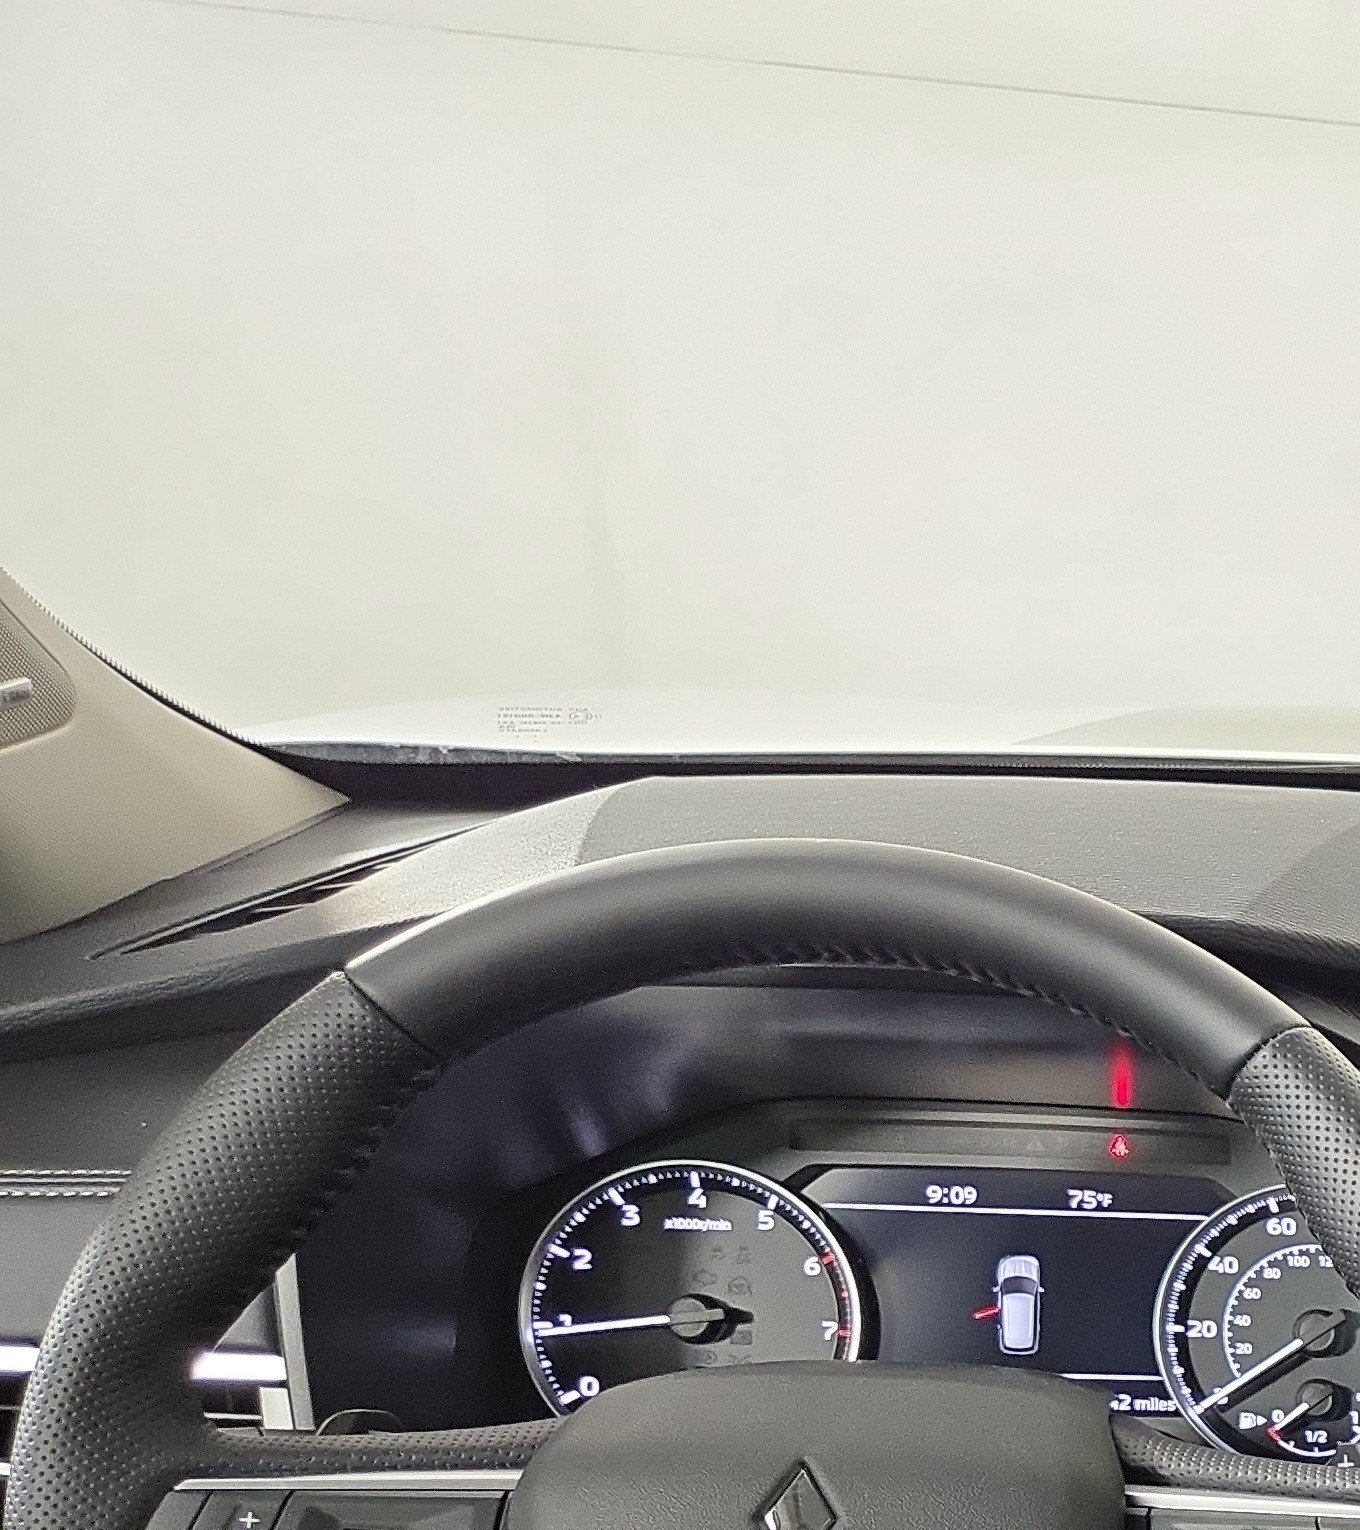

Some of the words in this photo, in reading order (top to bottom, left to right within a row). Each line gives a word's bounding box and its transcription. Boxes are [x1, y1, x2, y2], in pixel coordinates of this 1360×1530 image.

[688, 1188, 708, 1209] 4
[926, 1185, 978, 1205] 9:09
[620, 1205, 641, 1227] 3
[757, 1210, 776, 1231] 5
[1266, 1218, 1297, 1236] 60
[572, 1249, 593, 1271] 2
[803, 1257, 821, 1277] 6
[1208, 1256, 1239, 1274] 40
[1287, 1255, 1311, 1268] 100
[1263, 1267, 1281, 1279] 80
[1243, 1288, 1262, 1300] 60
[1186, 1320, 1218, 1338] 20
[1234, 1315, 1252, 1327] 40
[821, 1321, 838, 1342] 7
[1234, 1342, 1253, 1354] 20
[579, 1375, 600, 1397] 0
[1133, 1398, 1178, 1413] miles
[1271, 1409, 1285, 1424] 0
[1305, 1430, 1329, 1444] 1/2
